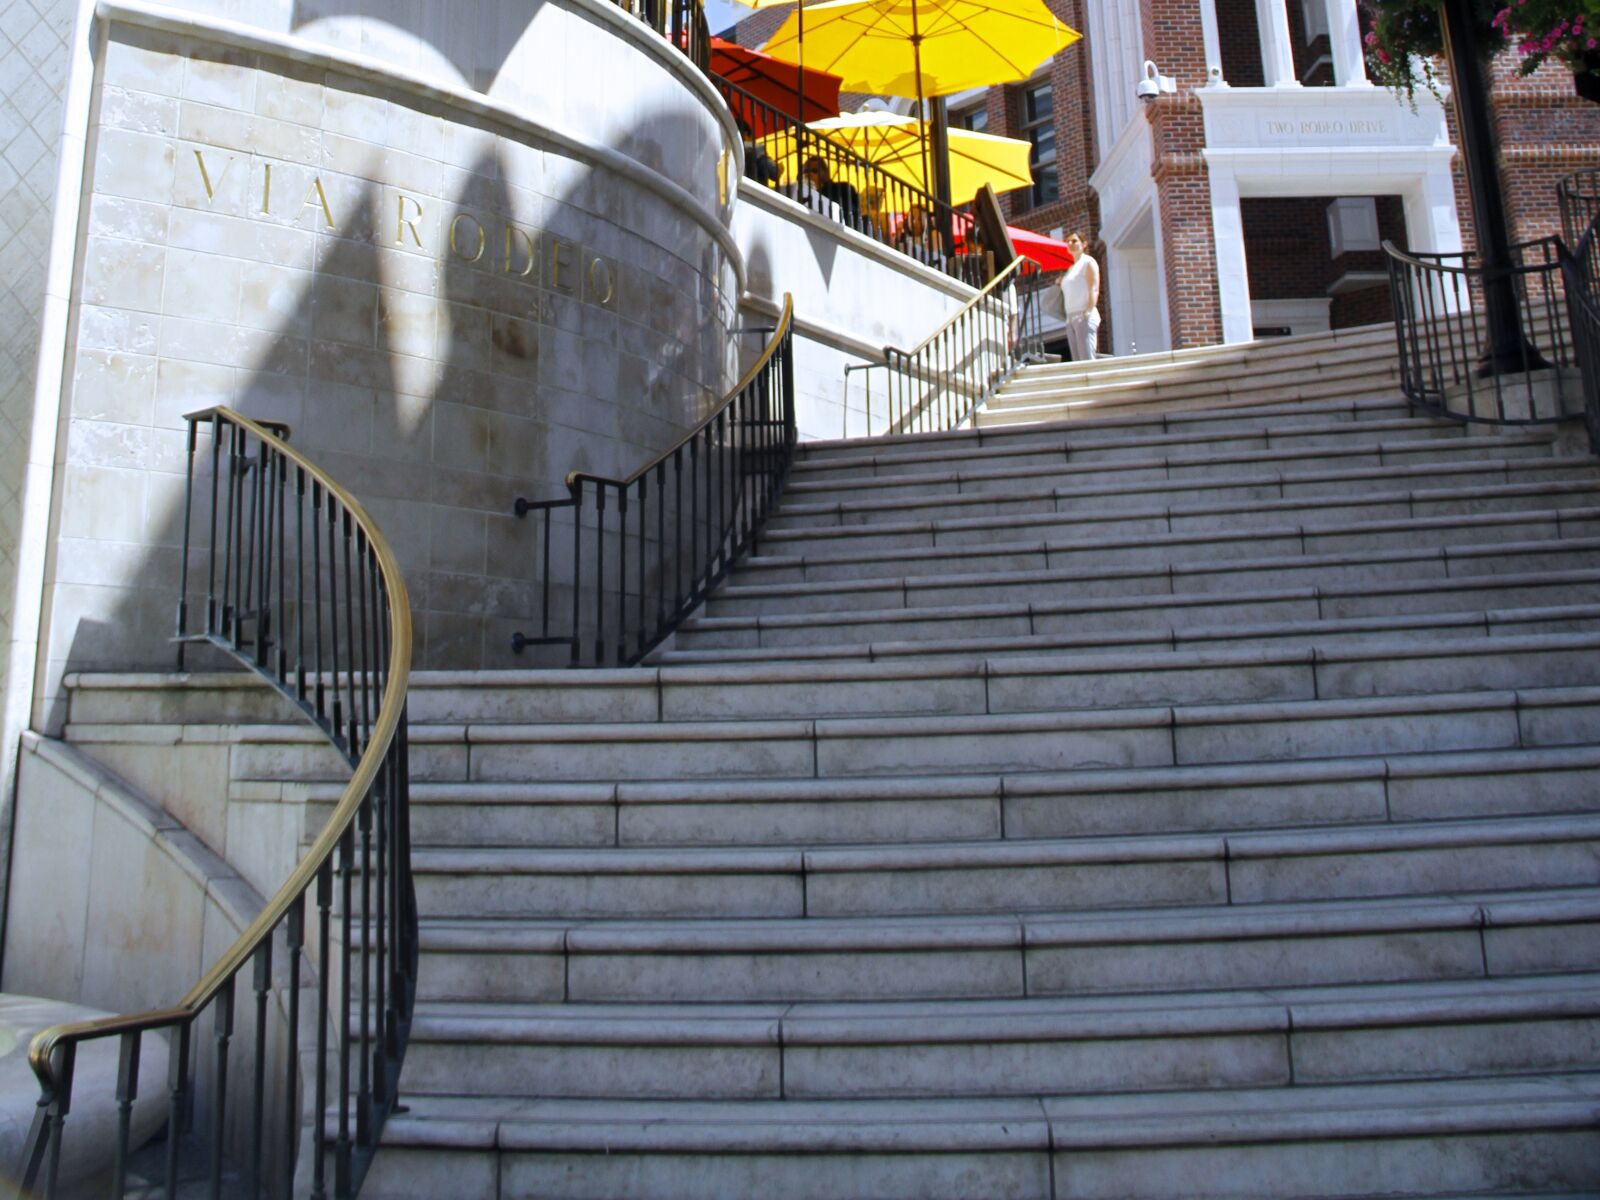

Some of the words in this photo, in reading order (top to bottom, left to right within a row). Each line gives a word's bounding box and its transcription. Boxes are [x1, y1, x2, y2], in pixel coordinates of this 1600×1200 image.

[1266, 120, 1294, 135] TWO
[1300, 120, 1343, 135] RODEO
[1349, 120, 1387, 134] DRIVE
[193, 150, 336, 230] VIA
[395, 194, 616, 304] RODEO
